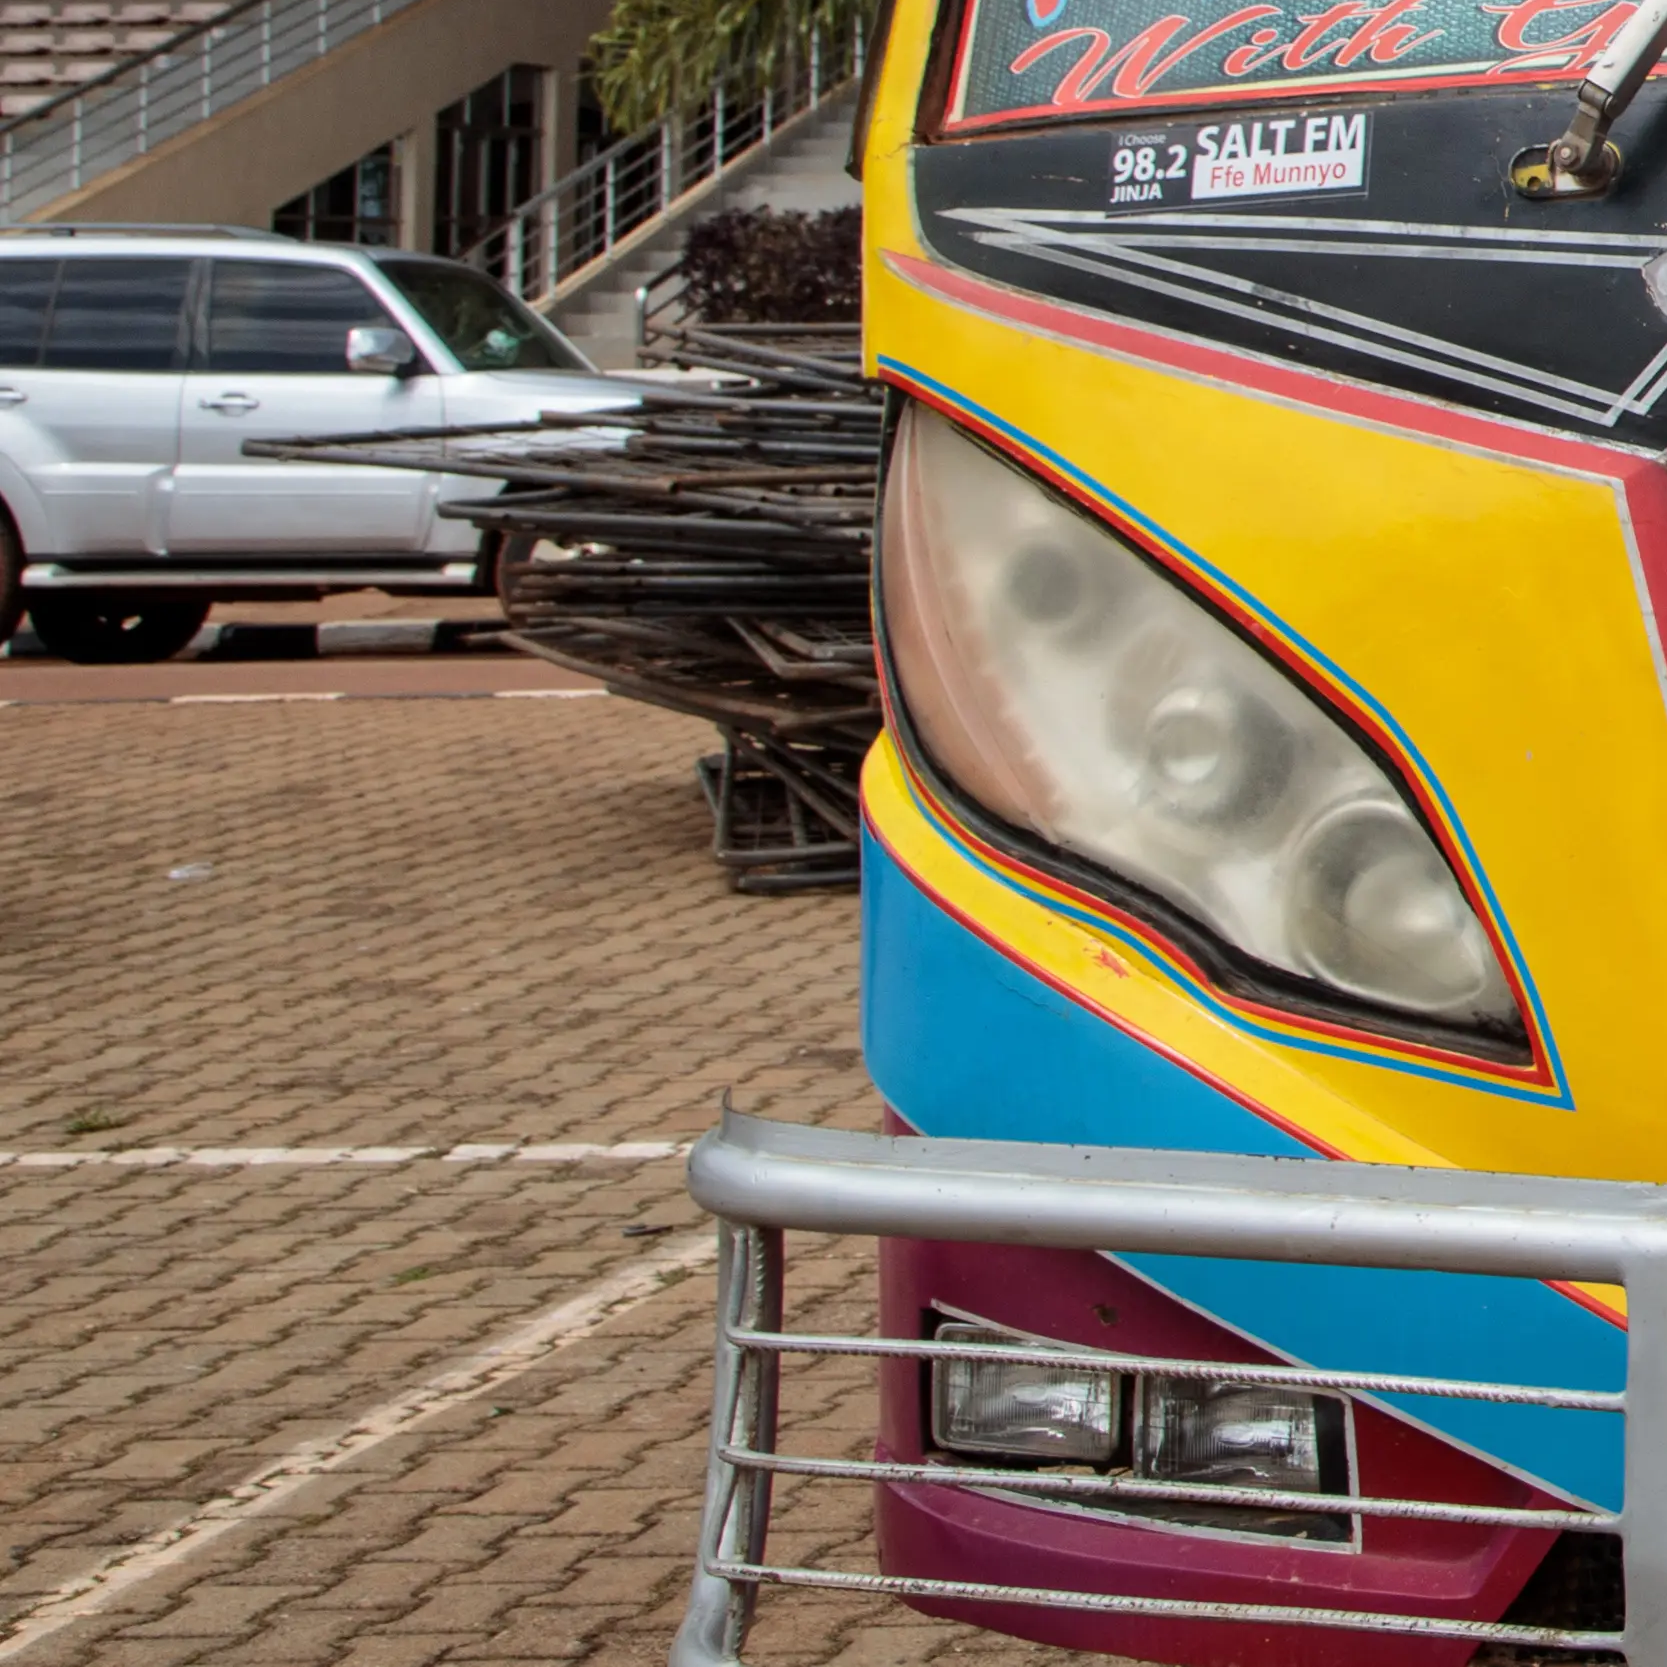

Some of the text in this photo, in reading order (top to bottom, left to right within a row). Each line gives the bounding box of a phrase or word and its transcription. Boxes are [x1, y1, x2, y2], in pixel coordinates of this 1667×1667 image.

[1112, 113, 1367, 184] 98.2 SALT FM
[1126, 134, 1167, 147] Choose
[1109, 161, 1347, 203] JINJA Ffe Munnyo
